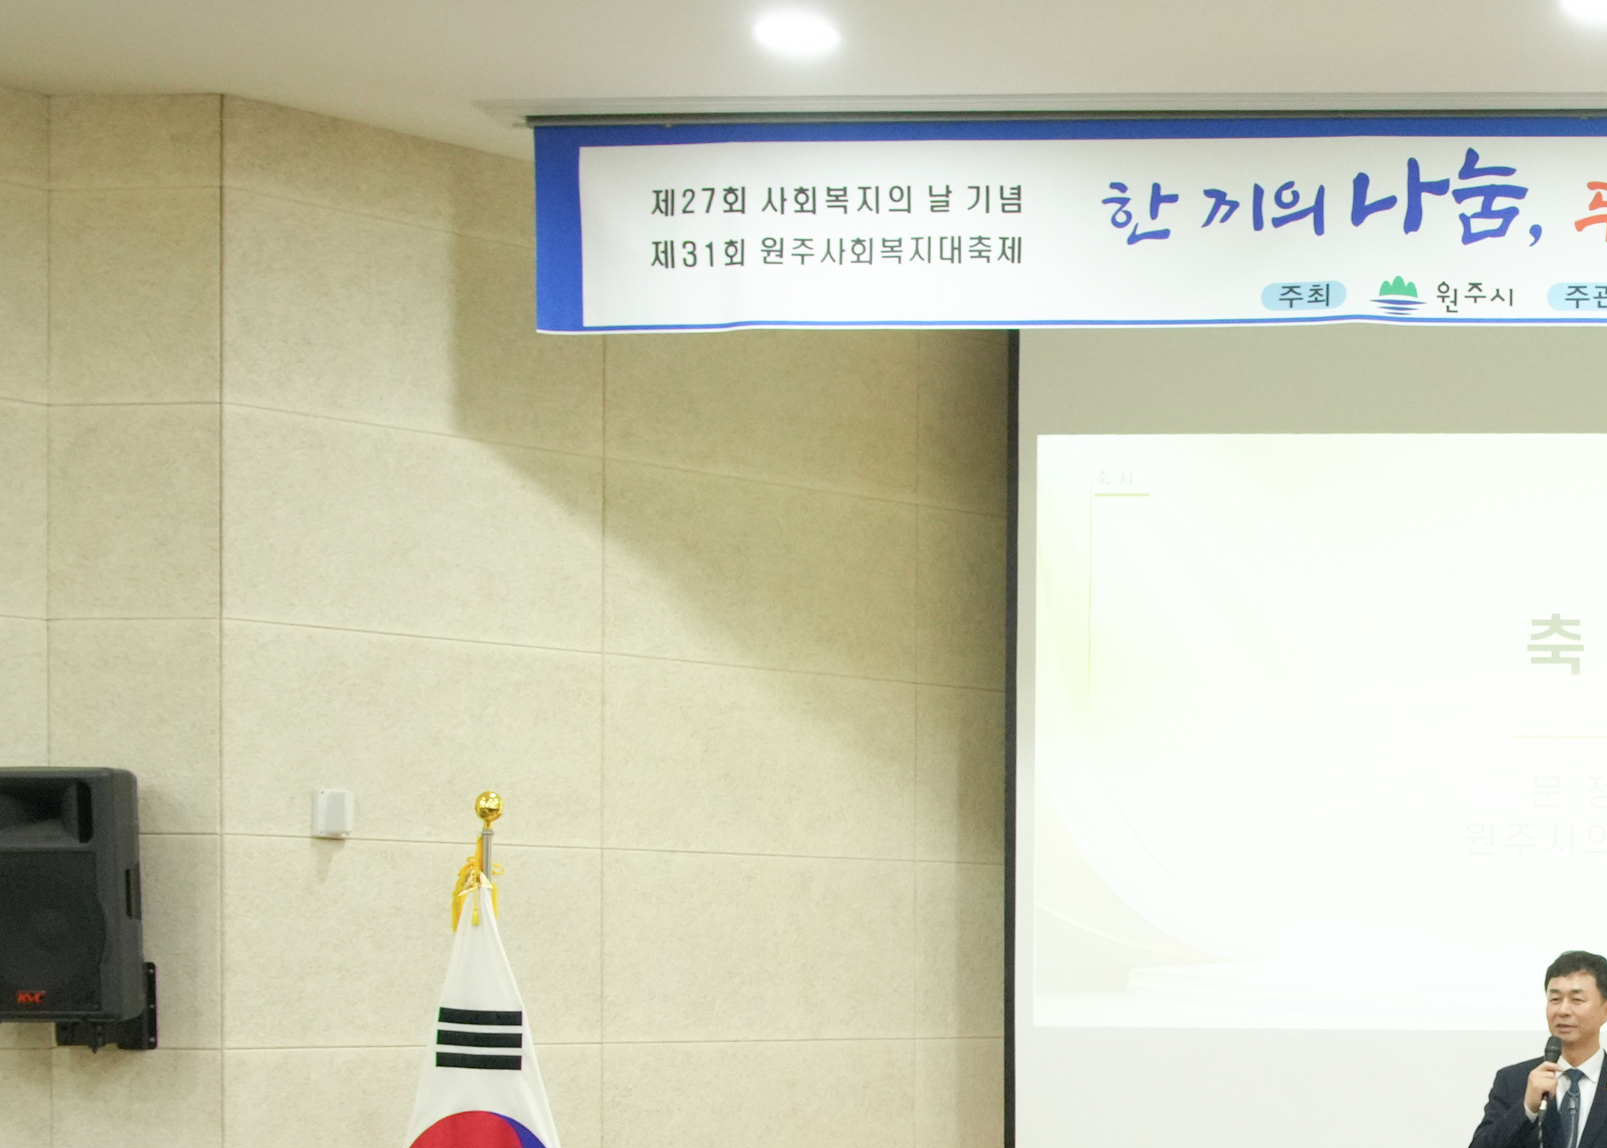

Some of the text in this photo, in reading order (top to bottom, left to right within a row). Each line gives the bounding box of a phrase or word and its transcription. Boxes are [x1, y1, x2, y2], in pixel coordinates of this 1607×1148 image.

[651, 184, 1023, 217] 제27회 사회복지의 날 기념
[1101, 182, 1179, 245] 한
[1201, 181, 1325, 236] 끼의
[1351, 147, 1543, 247] 나눔,
[651, 235, 1023, 268] 제31회 원주사회복지대축제
[1278, 283, 1331, 308] 주최
[1436, 281, 1514, 313] 원주시
